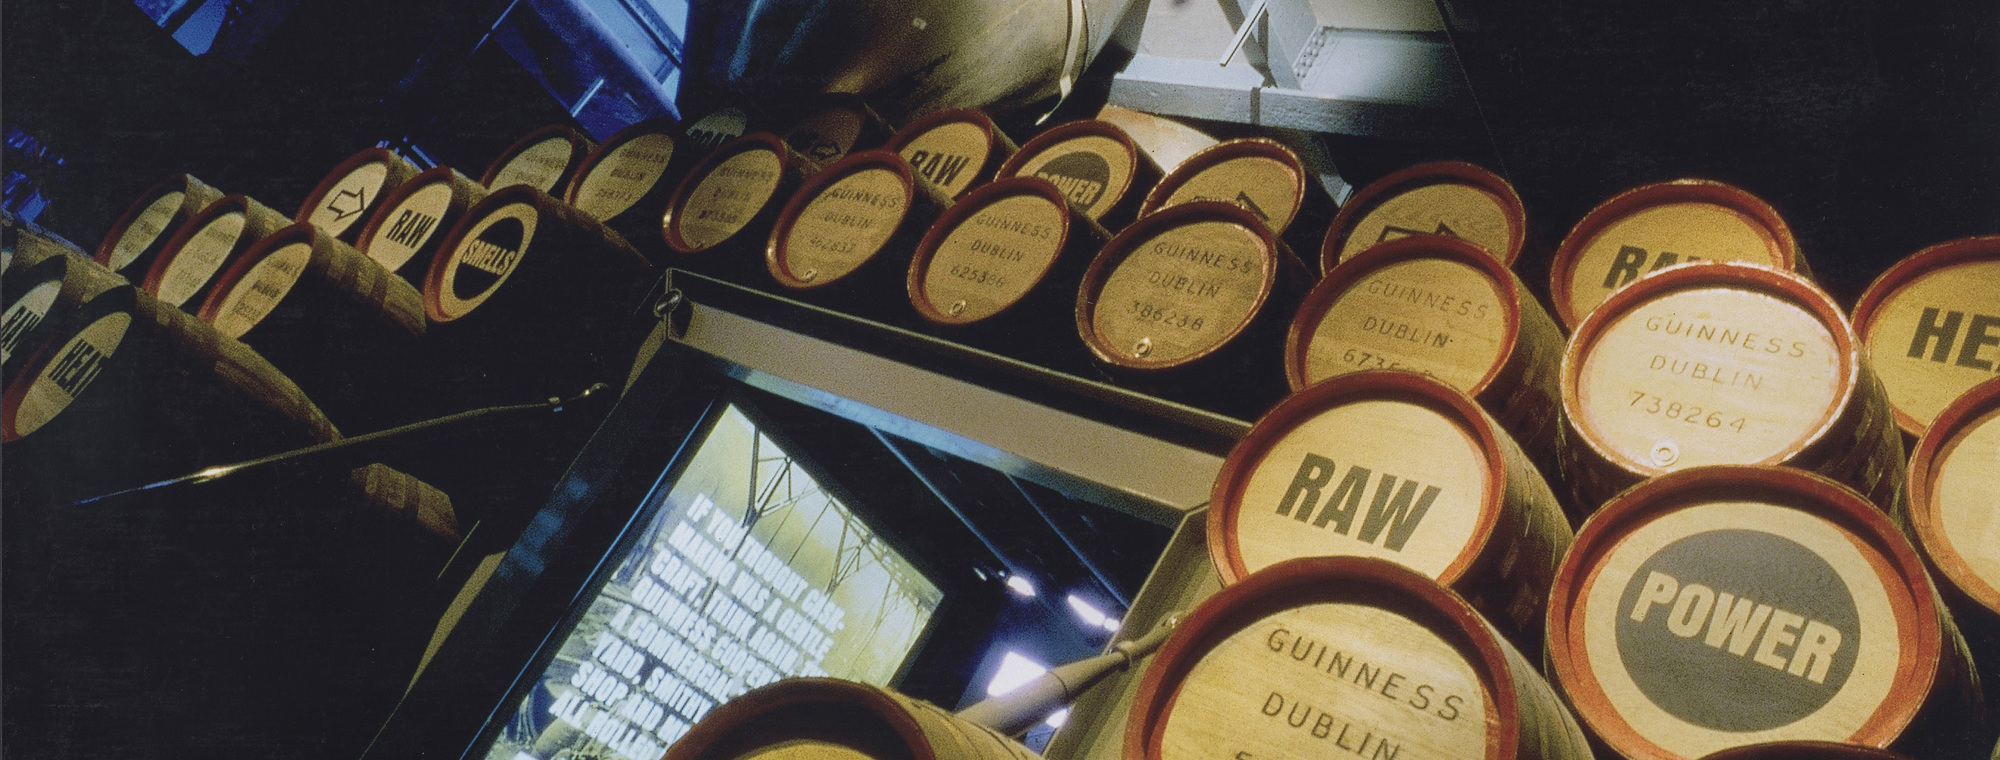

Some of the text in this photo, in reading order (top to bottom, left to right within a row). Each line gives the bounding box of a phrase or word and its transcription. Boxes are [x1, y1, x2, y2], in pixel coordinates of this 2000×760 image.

[832, 187, 898, 208] GUINNESS
[386, 209, 437, 249] RAW
[824, 211, 872, 228] DUBLIN
[976, 213, 1052, 239] GUINNESS
[462, 238, 516, 275] SMELLS
[970, 239, 1023, 262] DUBLIN
[1154, 241, 1253, 274] GUINNESS
[1150, 271, 1220, 298] DUBLIN
[1368, 280, 1488, 319] GUINNESS
[1363, 316, 1450, 348] DUBLIN
[1646, 316, 1808, 358] GUINNESS
[1650, 354, 1763, 391] DUBLIN
[1630, 391, 1746, 433] 738264
[1275, 452, 1442, 553] RAW
[687, 493, 714, 523] IF
[707, 508, 749, 552] YOU
[736, 534, 809, 603] THOUGHT
[668, 520, 834, 662] MAKING WAS A GENTLE
[631, 576, 716, 650] GUINNESS
[705, 590, 756, 641] THINK
[1630, 570, 1842, 685] POWER
[609, 604, 733, 704] A COMMERCIAL
[1267, 628, 1464, 721] GUINNESS
[549, 690, 590, 729] ALL
[571, 661, 629, 706] SHOP
[621, 693, 664, 731] AND
[645, 667, 713, 724] SMITHY
[1261, 692, 1400, 760] DUBLIN
